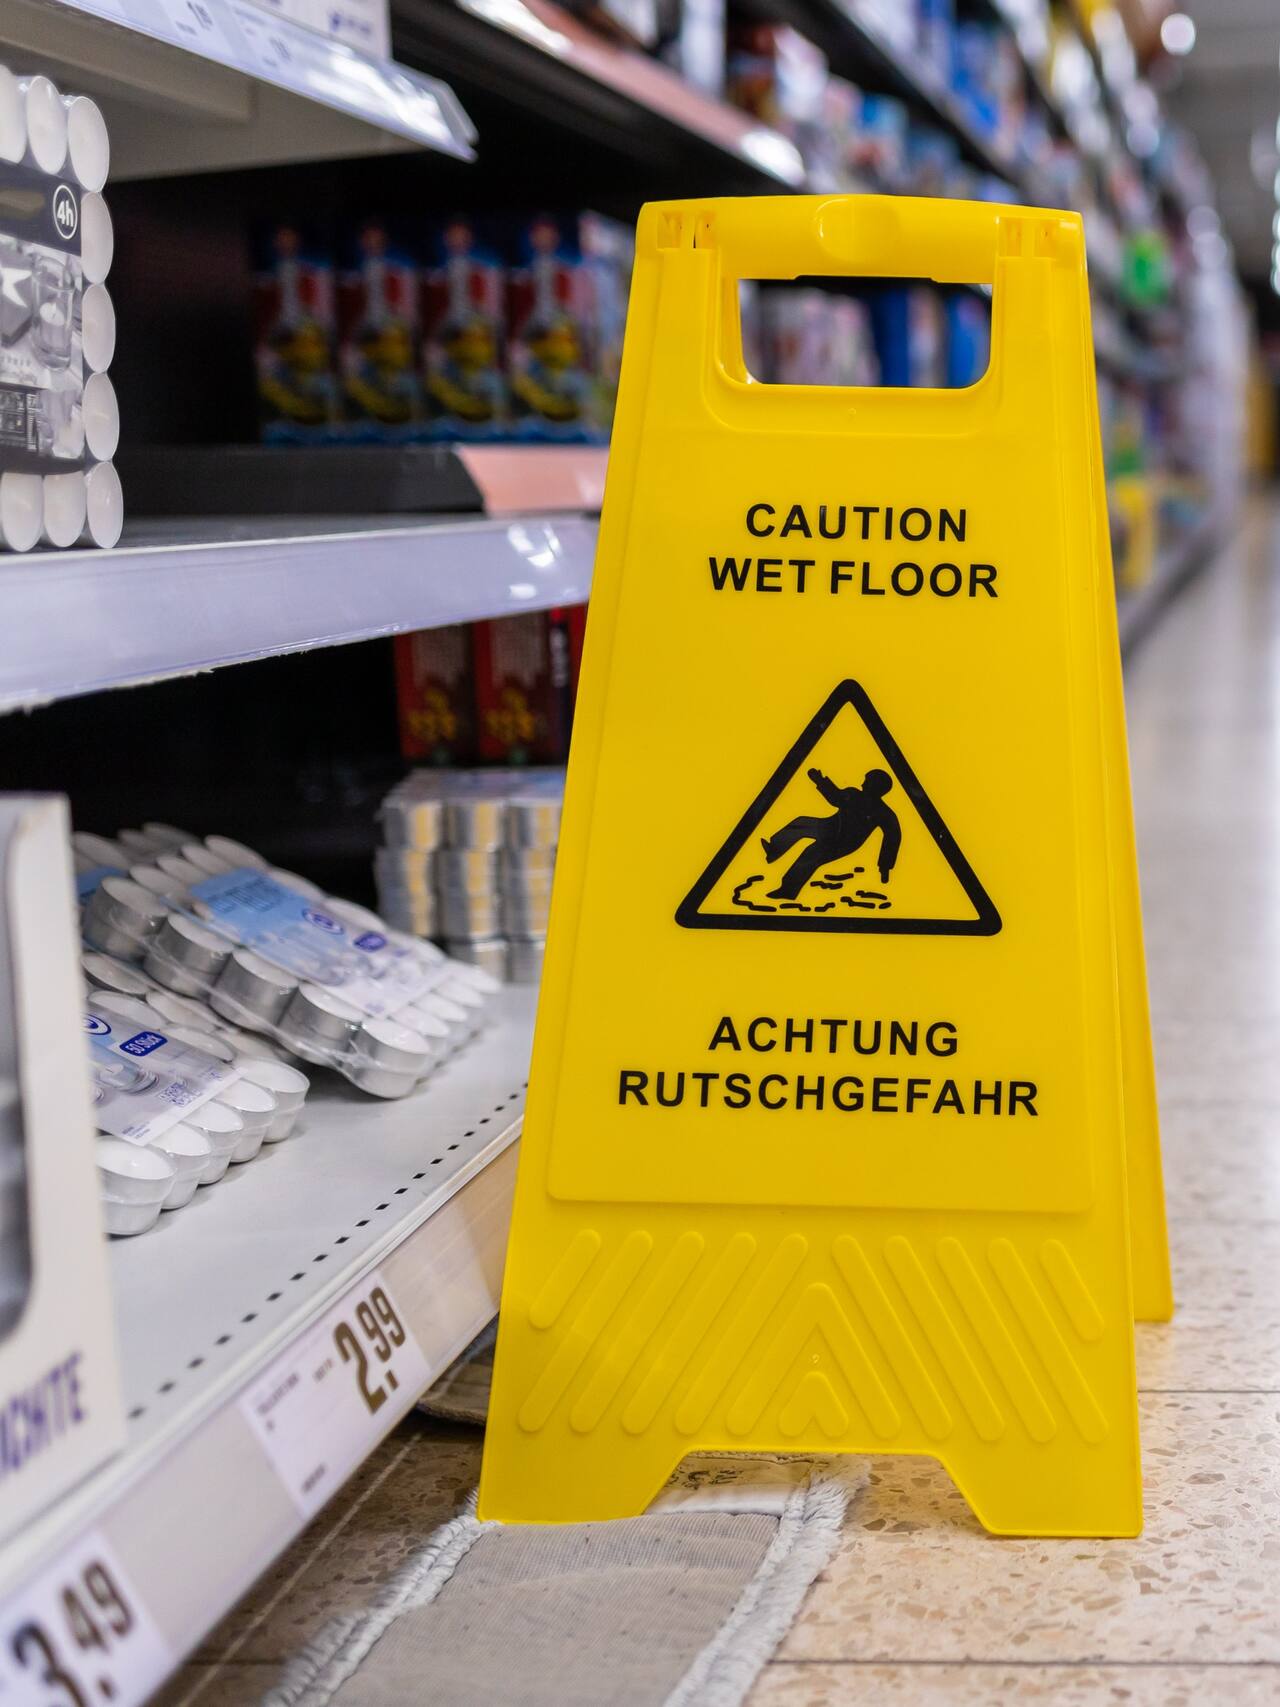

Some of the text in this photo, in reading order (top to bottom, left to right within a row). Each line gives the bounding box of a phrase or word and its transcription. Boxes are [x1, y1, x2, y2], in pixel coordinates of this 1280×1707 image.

[57, 200, 74, 228] 4h
[746, 503, 967, 542] CAUTION
[708, 557, 999, 598] WET FLOOR
[708, 1016, 958, 1057] ACHTUNG
[618, 1070, 1039, 1116] RUTSCHGEFAHR
[333, 1287, 406, 1416] 2.99
